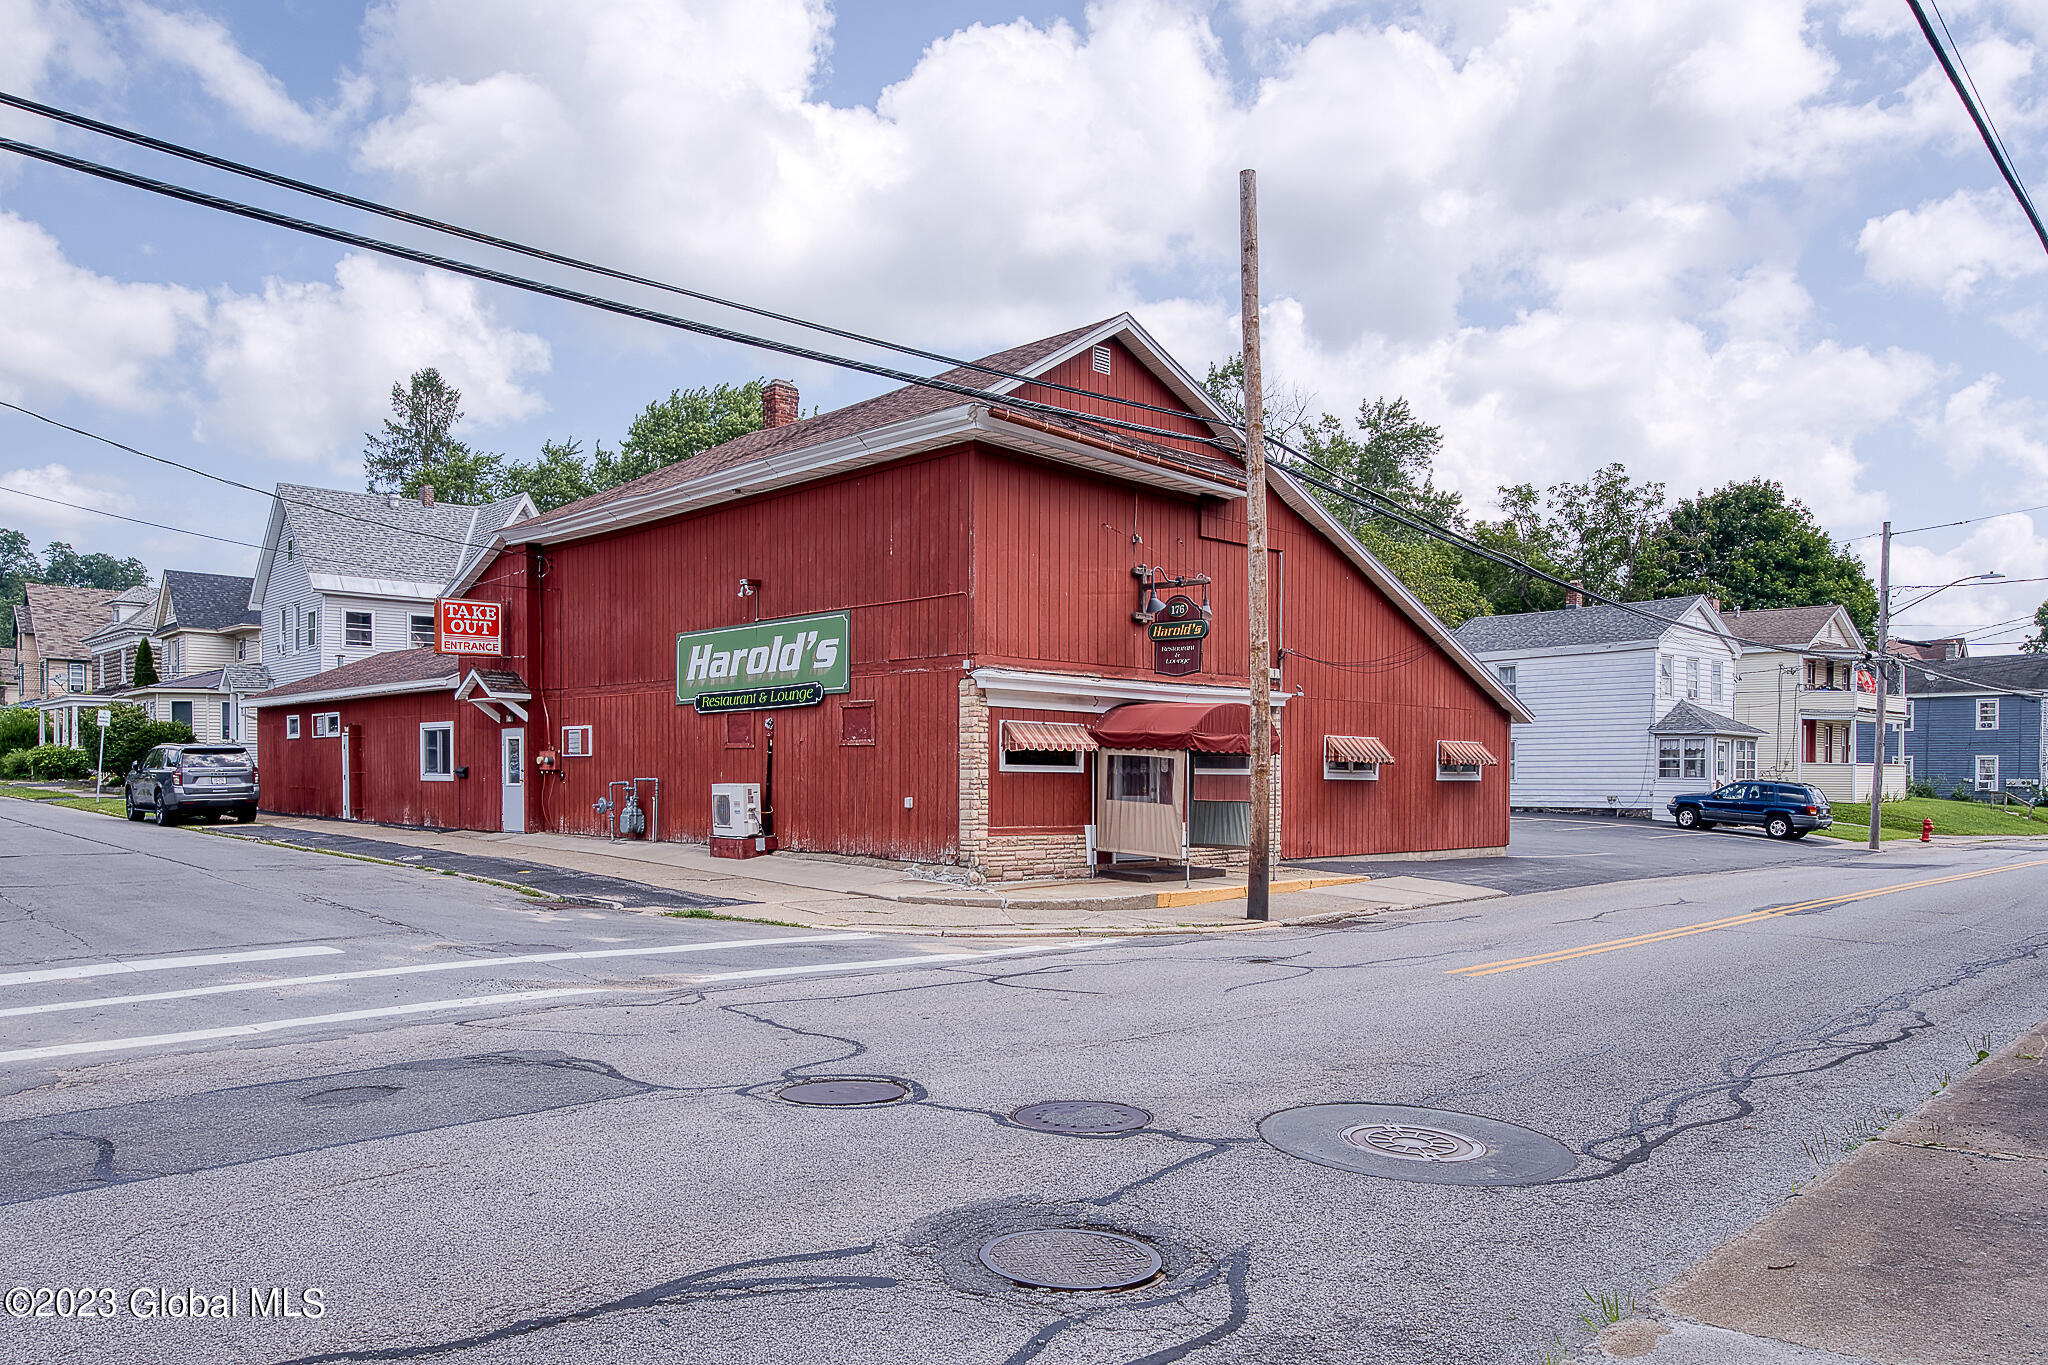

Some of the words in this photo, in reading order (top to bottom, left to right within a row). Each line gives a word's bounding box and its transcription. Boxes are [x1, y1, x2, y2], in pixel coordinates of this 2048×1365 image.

[445, 604, 497, 620] TAKE
[1171, 604, 1185, 615] 176
[450, 619, 492, 635] OUT
[1152, 623, 1203, 638] Harold's
[444, 640, 499, 652] ENTRANCE
[686, 630, 840, 682] Harold's
[702, 692, 756, 708] Restaurant
[758, 692, 768, 703] &
[770, 687, 815, 703] Lounge
